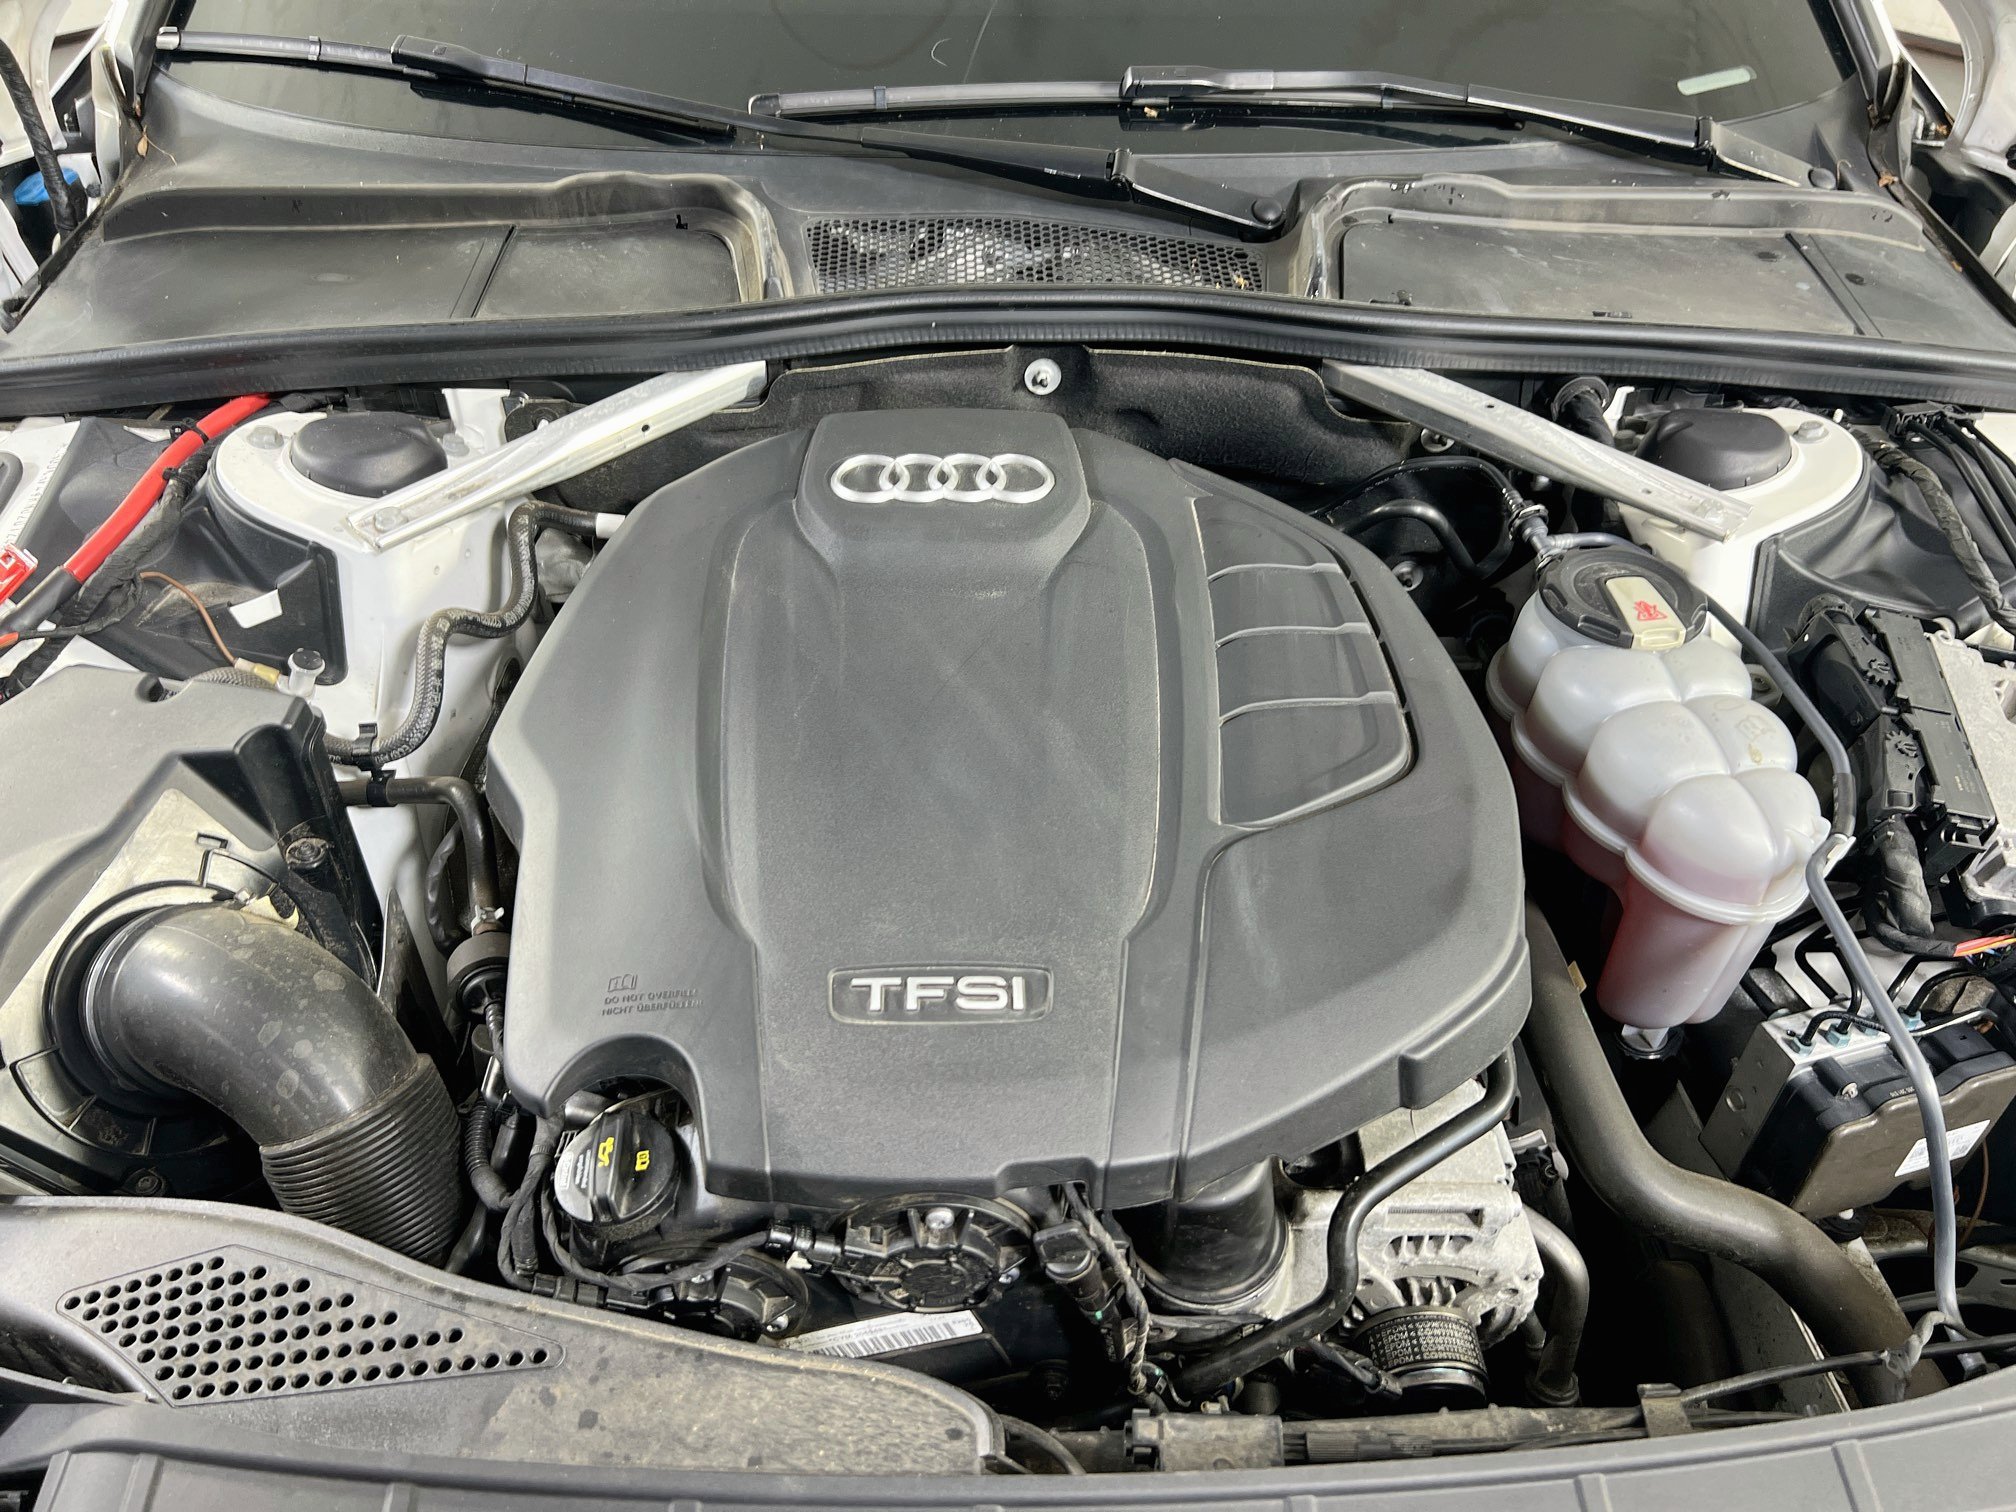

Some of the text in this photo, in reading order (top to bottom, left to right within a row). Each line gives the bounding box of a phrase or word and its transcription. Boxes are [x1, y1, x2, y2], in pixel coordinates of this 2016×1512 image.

[604, 996, 620, 1005] DO
[622, 993, 645, 1003] NOT
[850, 975, 1025, 1012] TFSI
